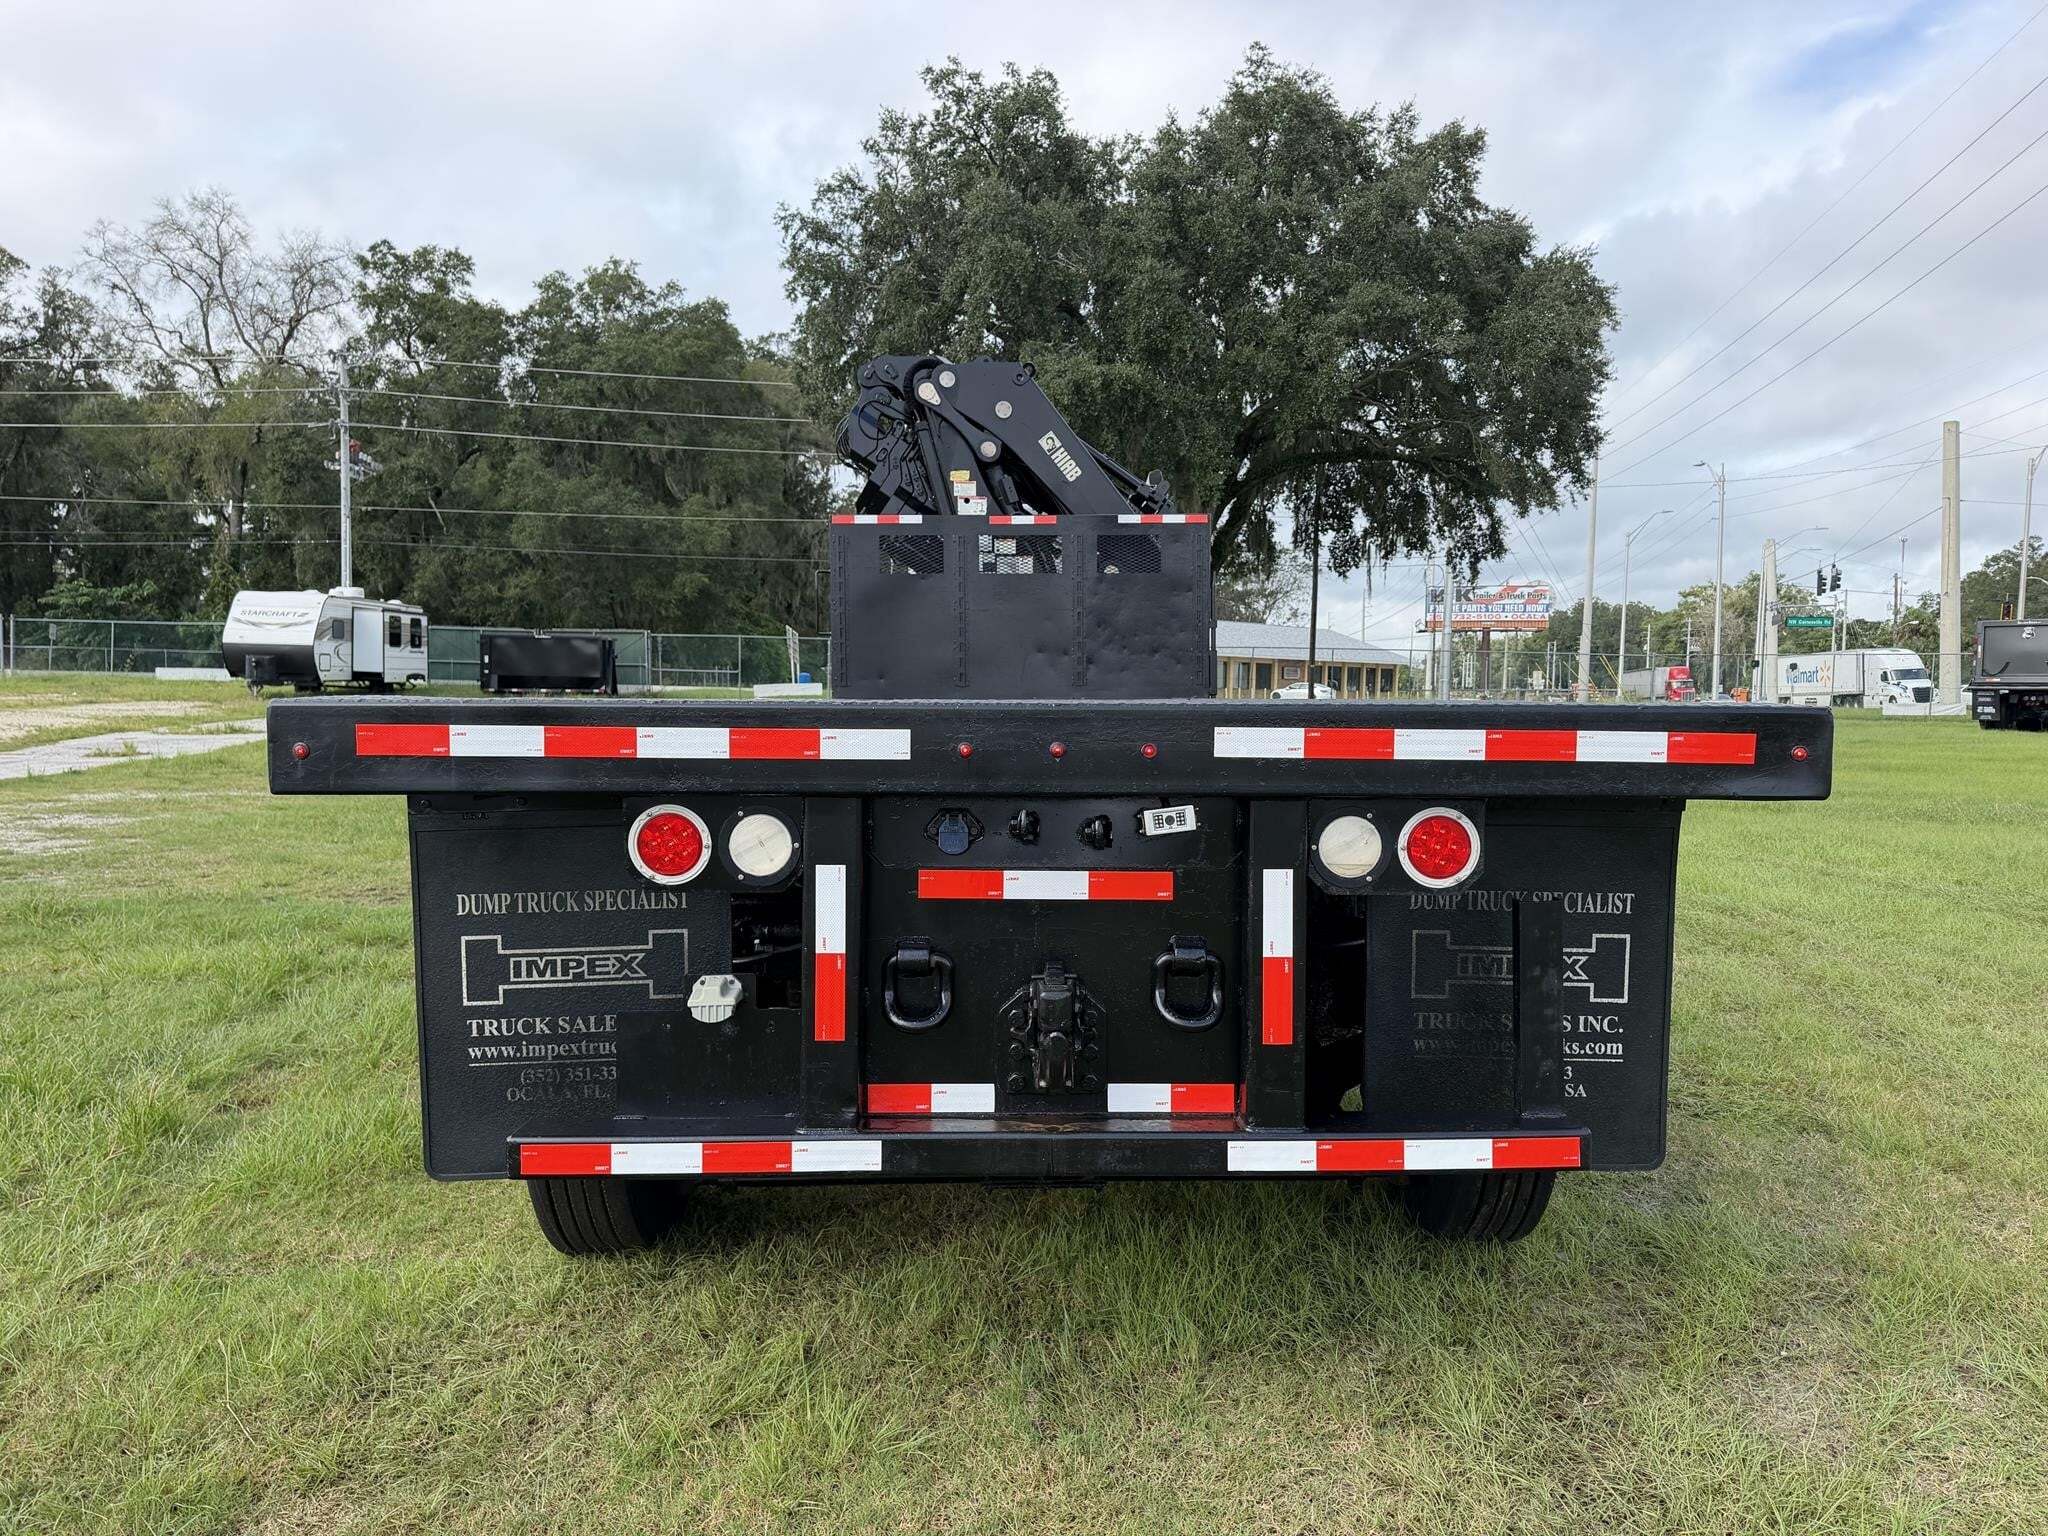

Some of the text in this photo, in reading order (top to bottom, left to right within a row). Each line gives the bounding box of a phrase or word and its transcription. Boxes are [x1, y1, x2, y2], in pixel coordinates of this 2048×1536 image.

[1050, 446, 1082, 482] HIAB
[1506, 591, 1526, 600] Truck
[1527, 591, 1547, 600] Parts
[1461, 604, 1486, 613] PARTS
[1488, 604, 1504, 613] YOU
[1504, 604, 1525, 613] NEED
[1526, 604, 1548, 613] NOW!
[1786, 665, 1819, 684] Walmart
[456, 888, 688, 916] DUMP TRUCK SPECIALIST
[1409, 893, 1463, 911] DUMP
[1466, 889, 1528, 912] TRUC
[510, 952, 648, 982] IMPEX
[467, 1014, 617, 1038] TRUCK SALE
[1577, 1015, 1624, 1034] INC.
[467, 1039, 617, 1061] www.impextru
[1564, 1083, 1588, 1098] SA
